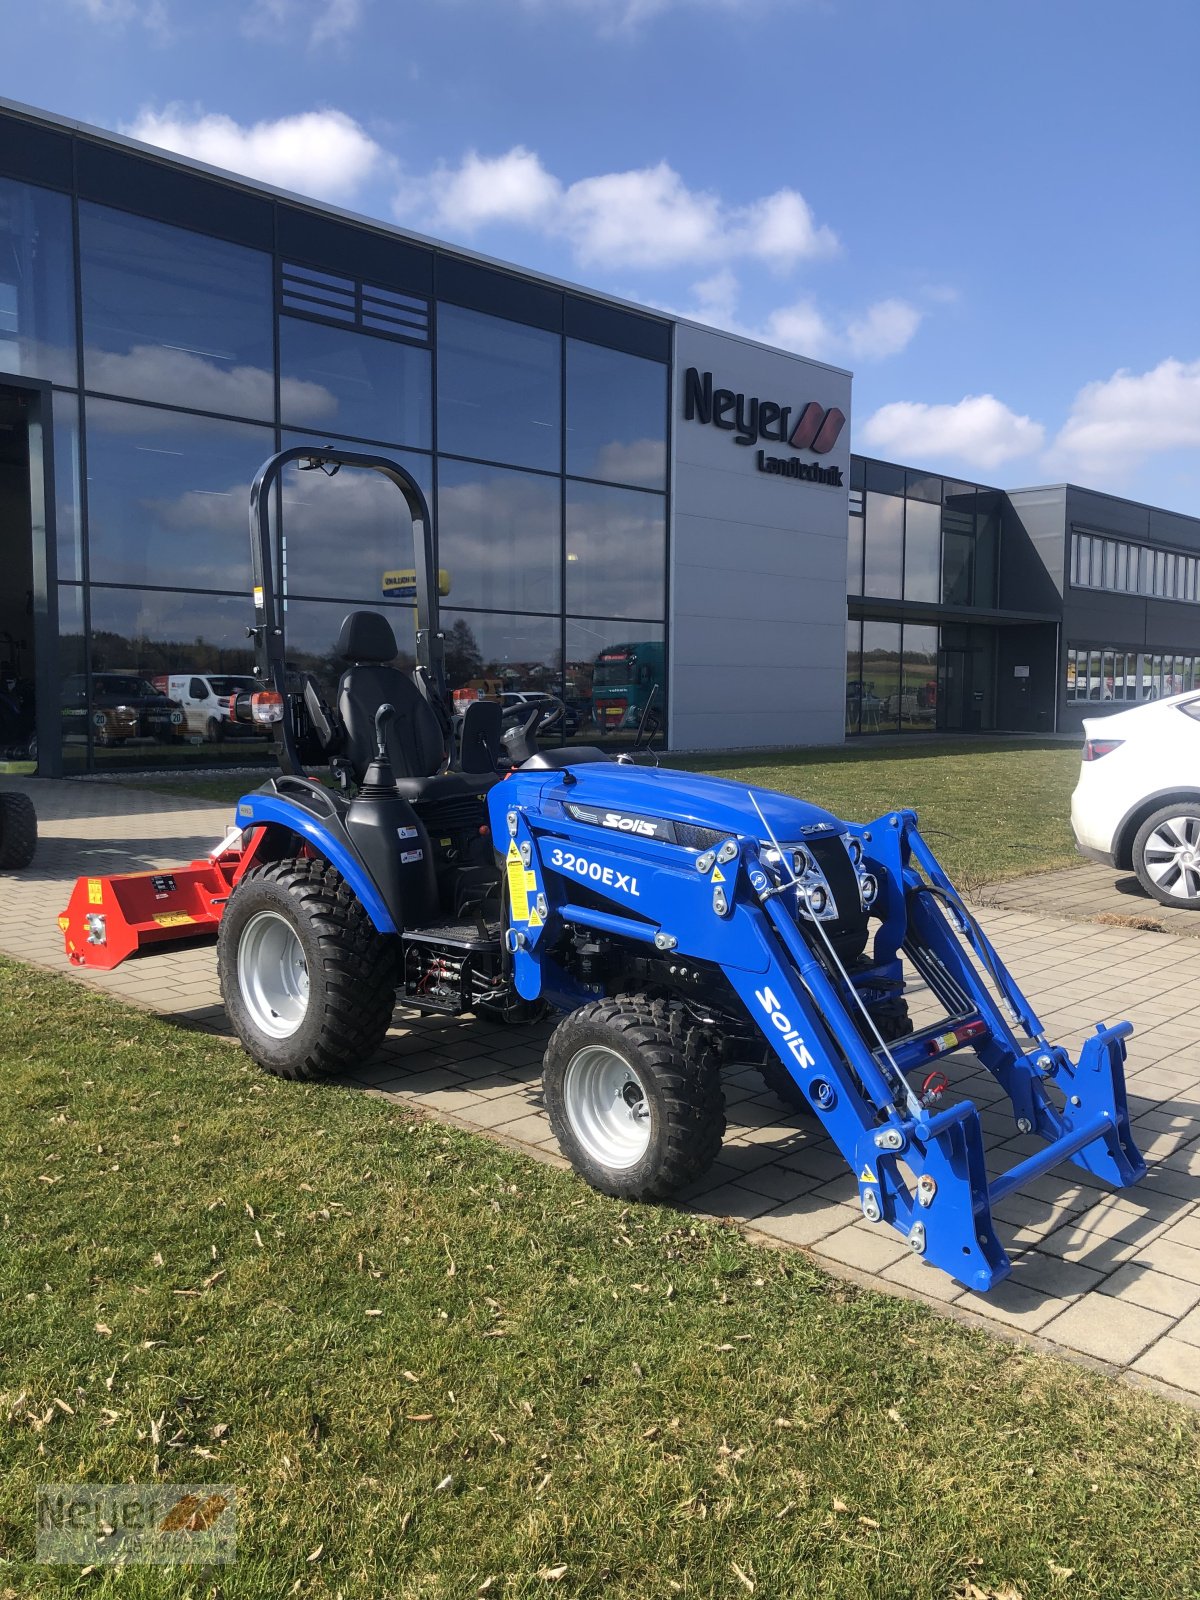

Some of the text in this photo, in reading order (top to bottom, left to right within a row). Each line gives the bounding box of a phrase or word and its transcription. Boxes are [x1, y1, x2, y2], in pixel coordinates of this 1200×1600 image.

[685, 367, 792, 446] Neyer
[758, 449, 843, 487] Landtechnik
[95, 714, 105, 724] 20
[172, 713, 181, 723] 20
